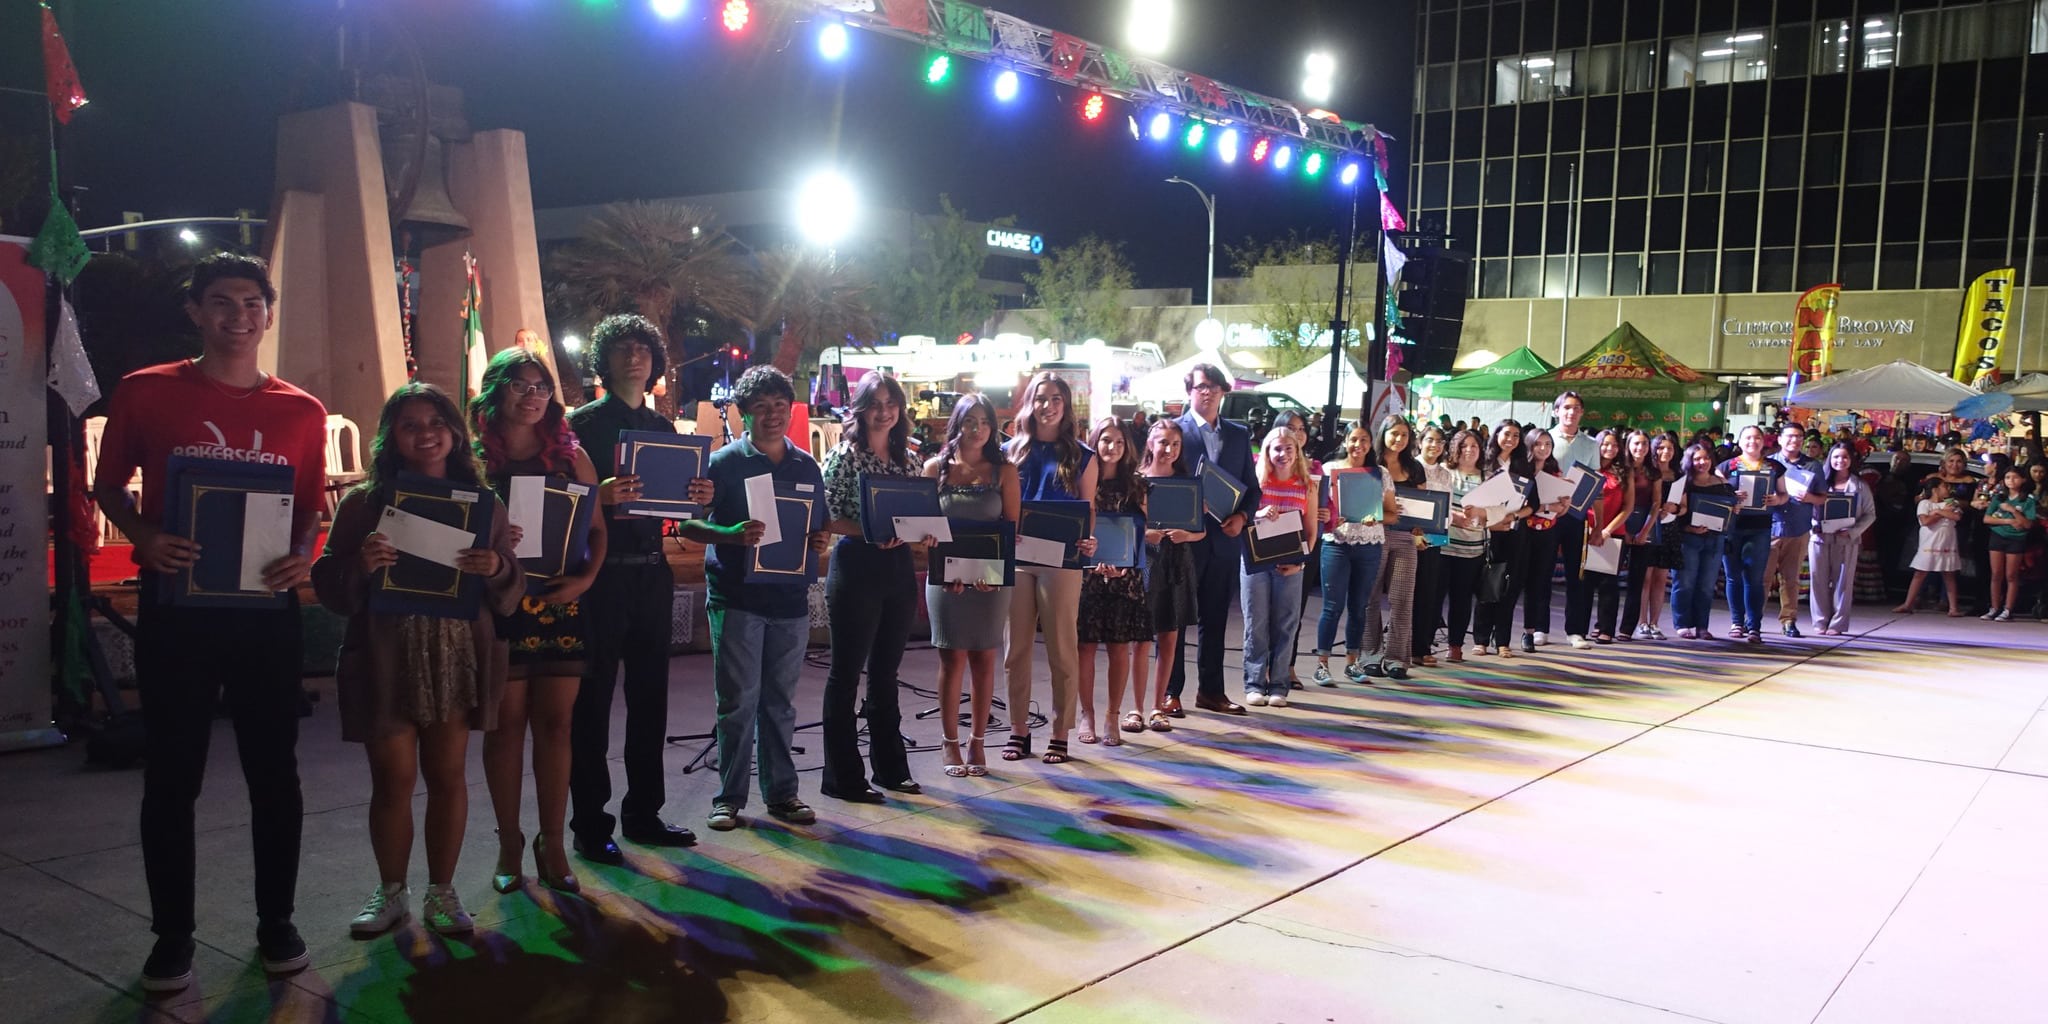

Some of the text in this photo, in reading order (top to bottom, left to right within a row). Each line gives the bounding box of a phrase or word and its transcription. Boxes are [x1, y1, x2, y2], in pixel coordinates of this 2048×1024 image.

[986, 229, 1031, 252] CHASE
[1723, 315, 1915, 336] CLIFFOR BROWN
[1977, 278, 2008, 370] TACOS
[2, 545, 28, 560] the
